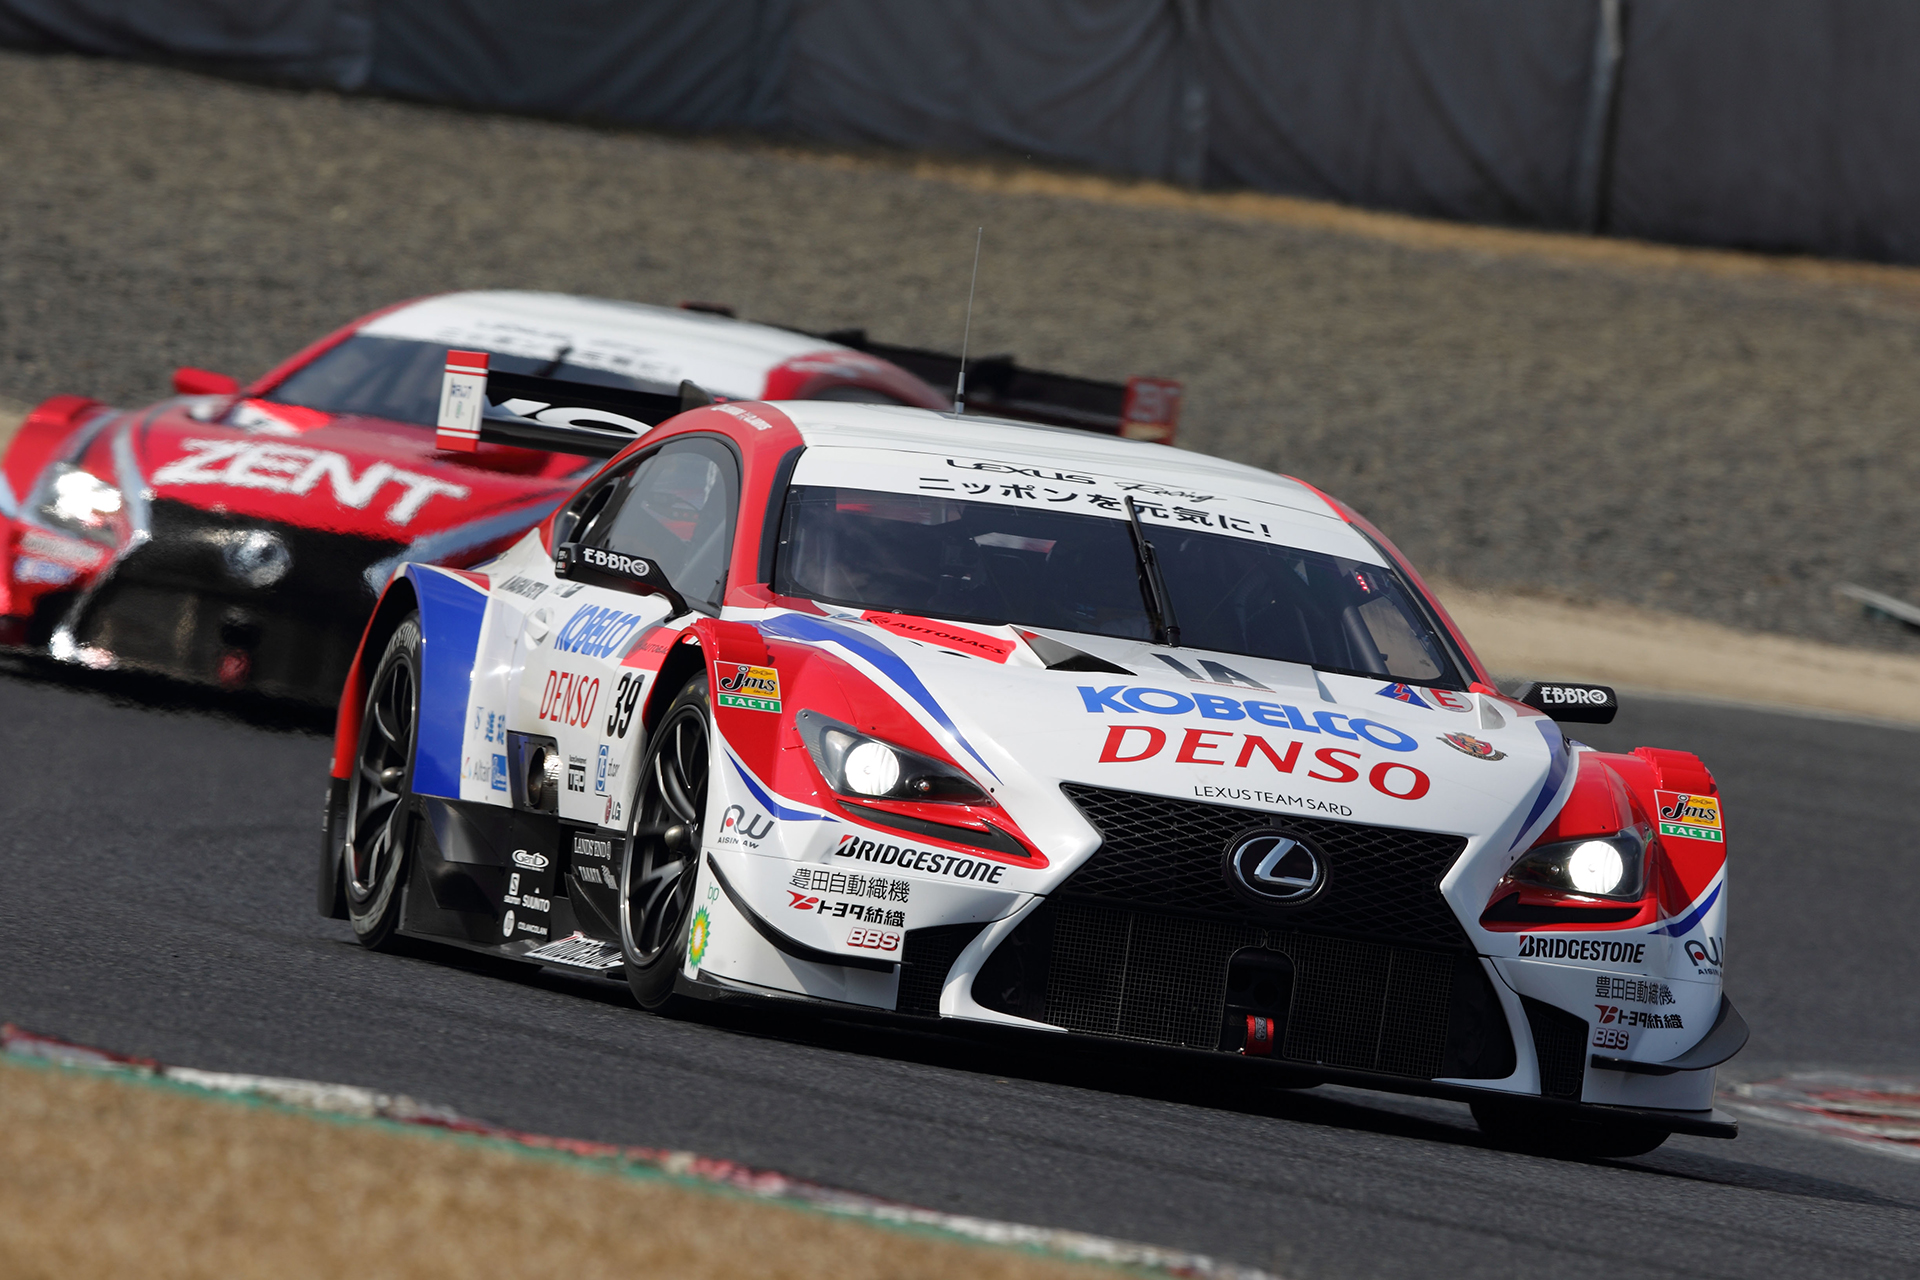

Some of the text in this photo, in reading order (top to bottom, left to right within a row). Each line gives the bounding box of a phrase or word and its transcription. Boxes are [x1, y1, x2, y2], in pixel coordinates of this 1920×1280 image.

[152, 438, 470, 527] ZENT
[946, 458, 1096, 485] LEXUS
[583, 547, 650, 577] EBBRO
[555, 603, 642, 659] KOBELCO
[890, 622, 1007, 655] AUTOBACS
[539, 670, 600, 729] DENSO
[607, 672, 645, 739] 39
[724, 696, 775, 710] TACTI
[1541, 686, 1608, 704] EBBRO
[1076, 685, 1419, 752] KOBELCO
[1098, 725, 1431, 800] DENSO
[1194, 785, 1353, 817] LEXUS TEAM SARD
[1666, 825, 1716, 839] TACTI
[835, 834, 1007, 884] BRIDGESTONE
[708, 882, 720, 904] bp
[789, 868, 911, 903] 豊田自動織機
[816, 899, 906, 929] トヨタ紡織
[847, 927, 901, 951] BBS
[1518, 934, 1646, 963] BRIDGESTONE
[1595, 976, 1676, 1006] 豊田自動織機
[1617, 1009, 1685, 1029] トヨタ紡織
[1592, 1027, 1630, 1050] BBS
